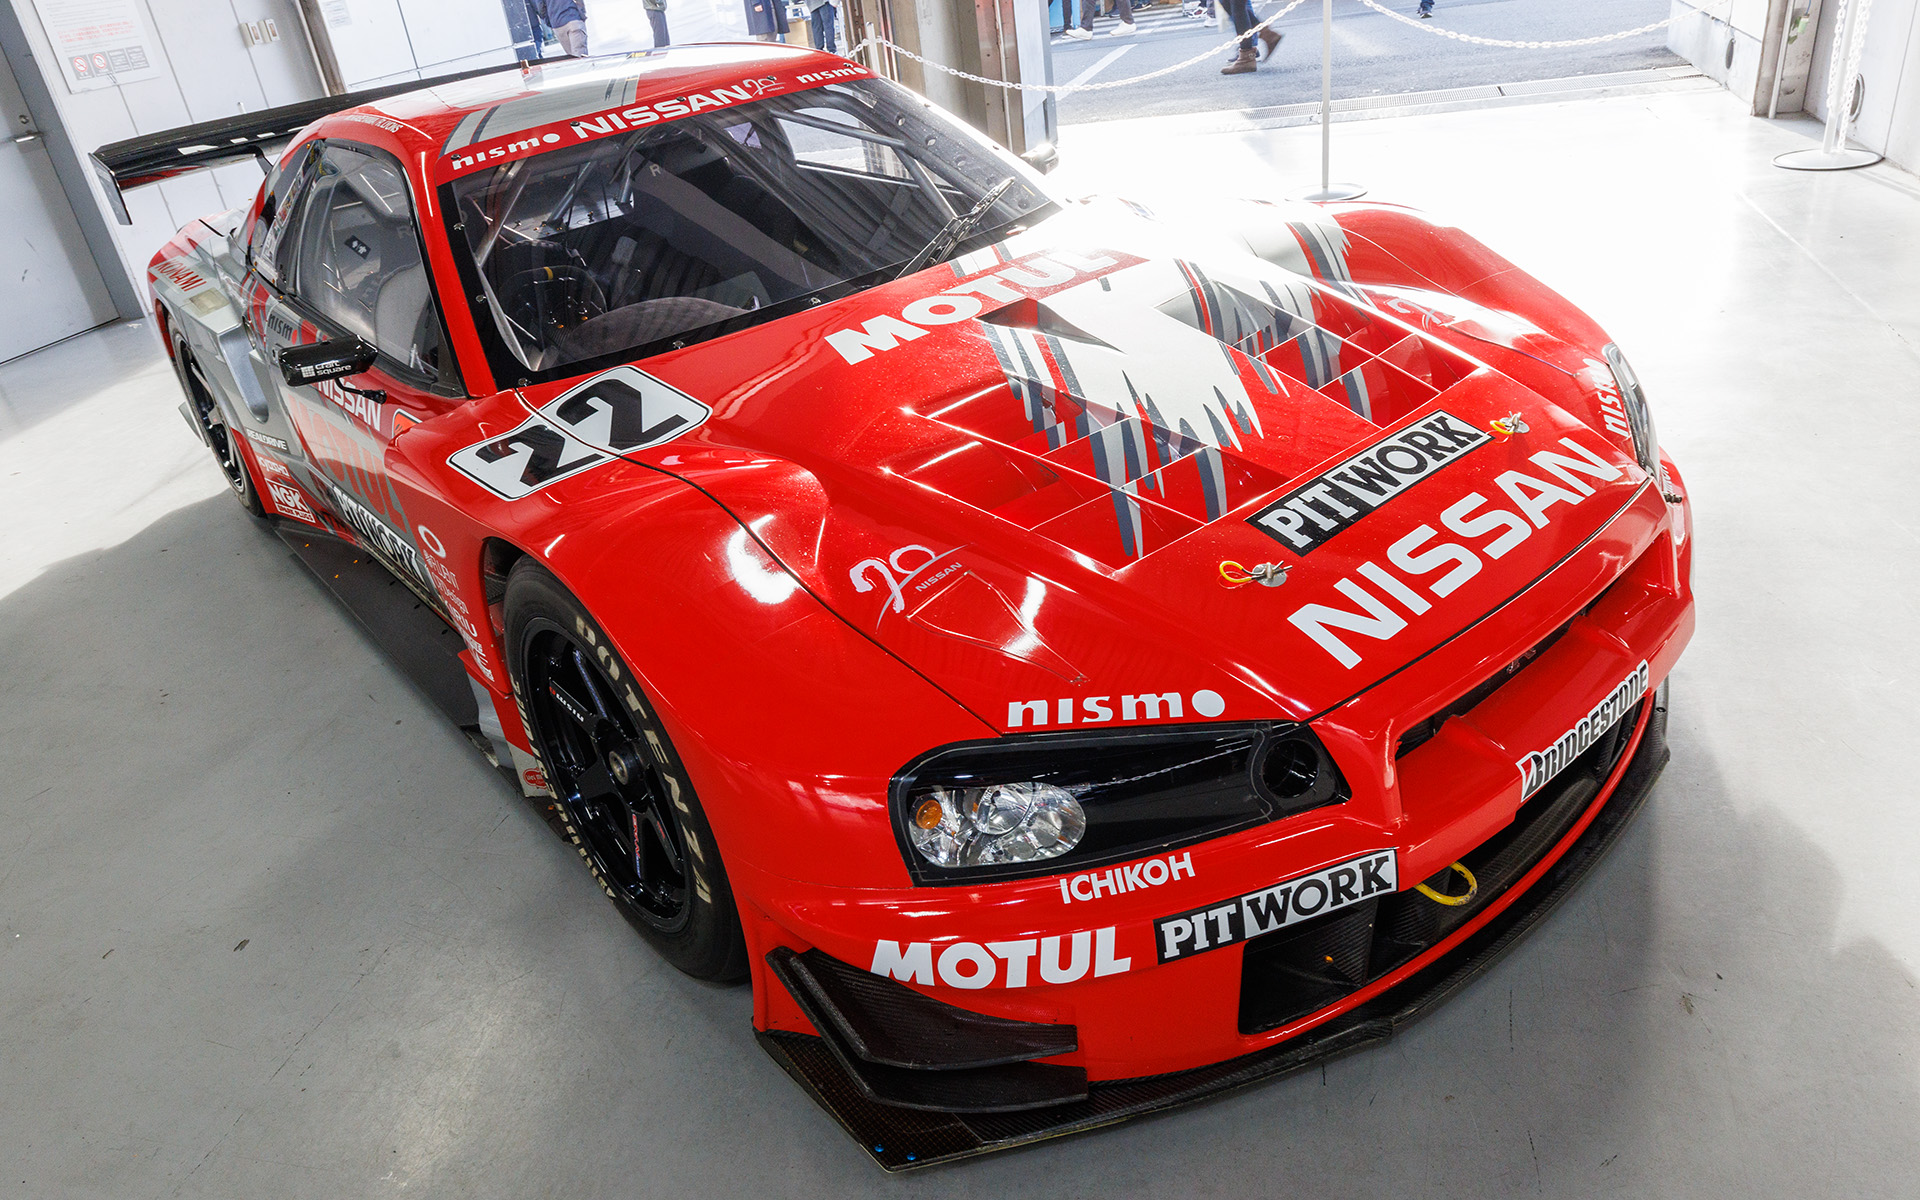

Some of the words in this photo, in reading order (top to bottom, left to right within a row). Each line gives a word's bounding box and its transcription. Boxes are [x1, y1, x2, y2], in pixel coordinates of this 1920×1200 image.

[570, 85, 752, 139] NISSAN
[824, 250, 1119, 366] MOTUL
[316, 365, 352, 377] square
[318, 377, 382, 432] NISSAN
[475, 379, 689, 487] 22
[266, 482, 309, 512] NGK
[915, 562, 962, 592] NISSAN
[1287, 437, 1624, 670] NISSAN
[1519, 662, 1648, 801] BRIDGESTONE
[1060, 852, 1196, 904] ICHIKOH
[870, 926, 1132, 990] MOTUL
